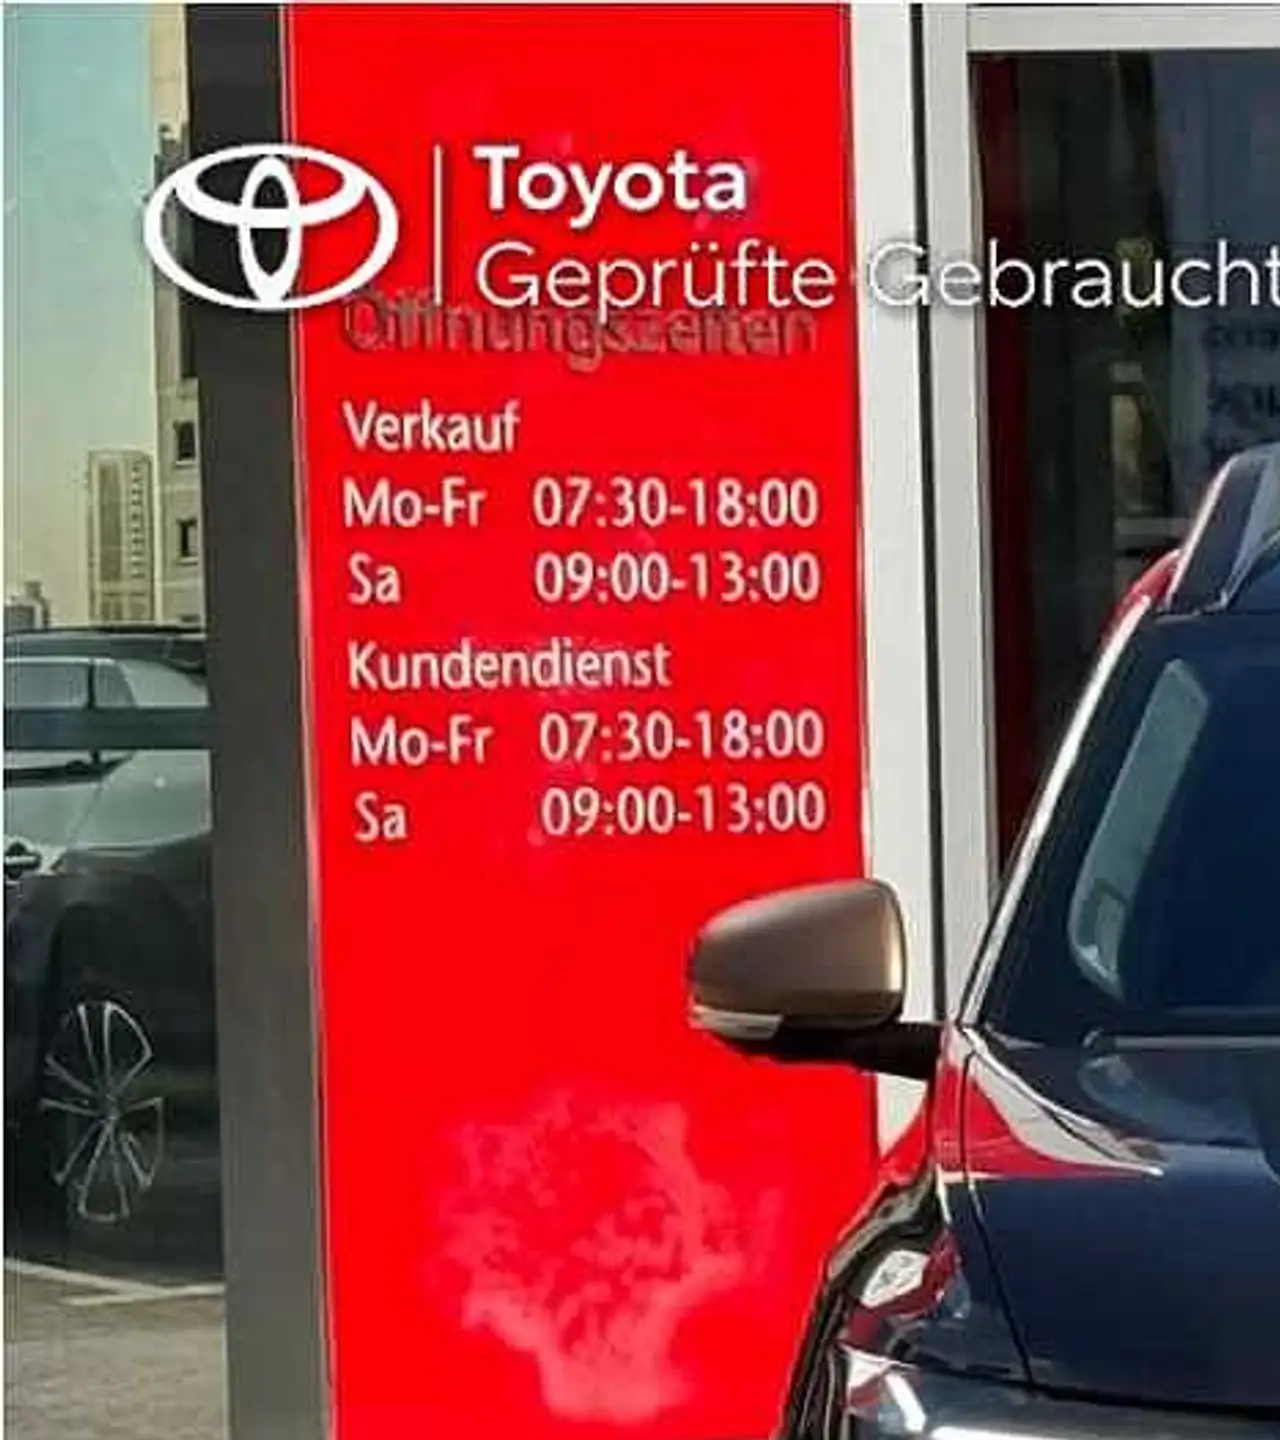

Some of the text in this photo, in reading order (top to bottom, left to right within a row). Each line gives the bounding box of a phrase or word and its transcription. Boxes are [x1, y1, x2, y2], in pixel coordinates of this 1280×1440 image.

[342, 400, 520, 452] Verkauf
[343, 477, 819, 528] Mo-Fr 07:30-18:00
[348, 552, 821, 603] Sa 09:00-13:00
[348, 640, 672, 691] Kundendienst
[350, 710, 824, 766] Mo-Fr 07:30-18:00
[355, 784, 826, 842] Sa 09:00-13:00
